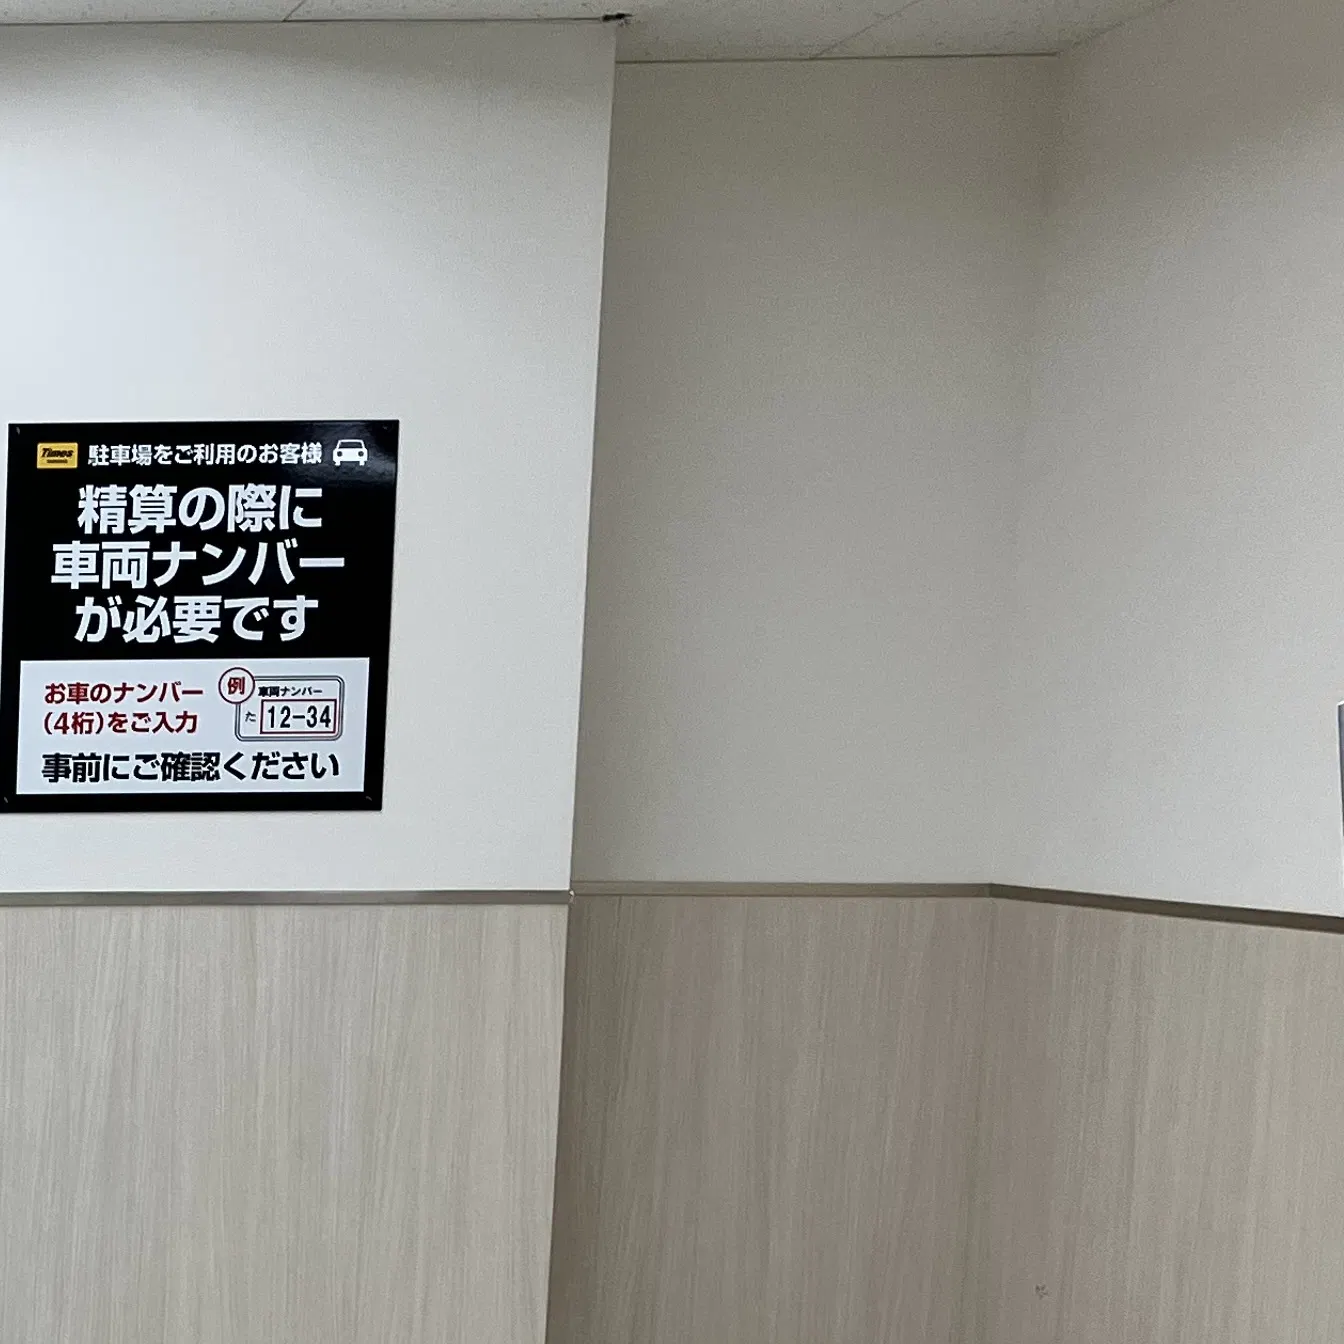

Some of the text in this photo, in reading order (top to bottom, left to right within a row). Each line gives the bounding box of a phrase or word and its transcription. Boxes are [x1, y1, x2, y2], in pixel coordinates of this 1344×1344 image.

[41, 447, 74, 458] Times
[87, 441, 323, 467] 駐車場をご利用のお客様
[77, 483, 323, 534] 精算の際に
[50, 537, 345, 589] 車両ナンバー
[74, 594, 319, 644] が必要です
[44, 681, 204, 704] お車のナンバー
[227, 677, 246, 695] 例
[245, 711, 257, 722] た
[267, 705, 332, 728] 12-34
[41, 752, 340, 783] 事前にご確認ください
